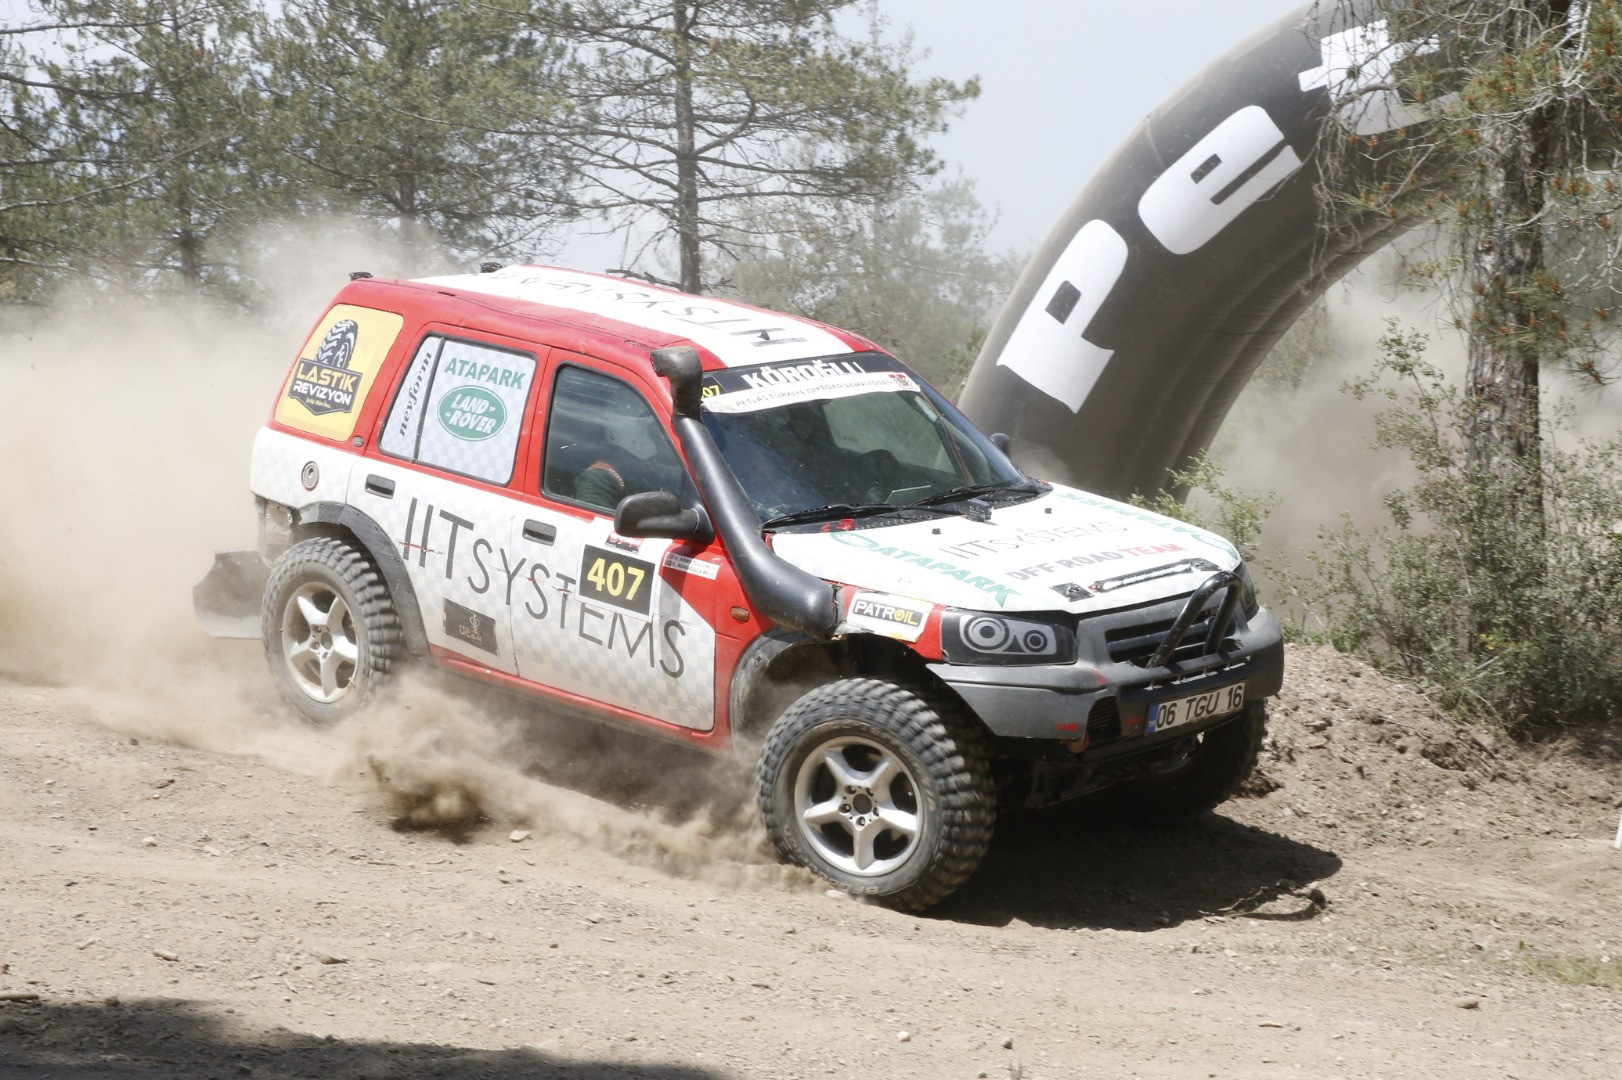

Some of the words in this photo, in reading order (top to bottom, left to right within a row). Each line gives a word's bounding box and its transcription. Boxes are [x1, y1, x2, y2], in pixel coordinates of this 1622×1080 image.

[444, 357, 526, 390] ATAPARK
[586, 556, 646, 602] 407
[872, 547, 1022, 608] ATAPARK
[1006, 556, 1058, 581] OFF
[854, 600, 919, 626] PATROIL
[1156, 702, 1178, 729] 06
[1185, 691, 1221, 721] TGU
[1227, 685, 1243, 710] 16
